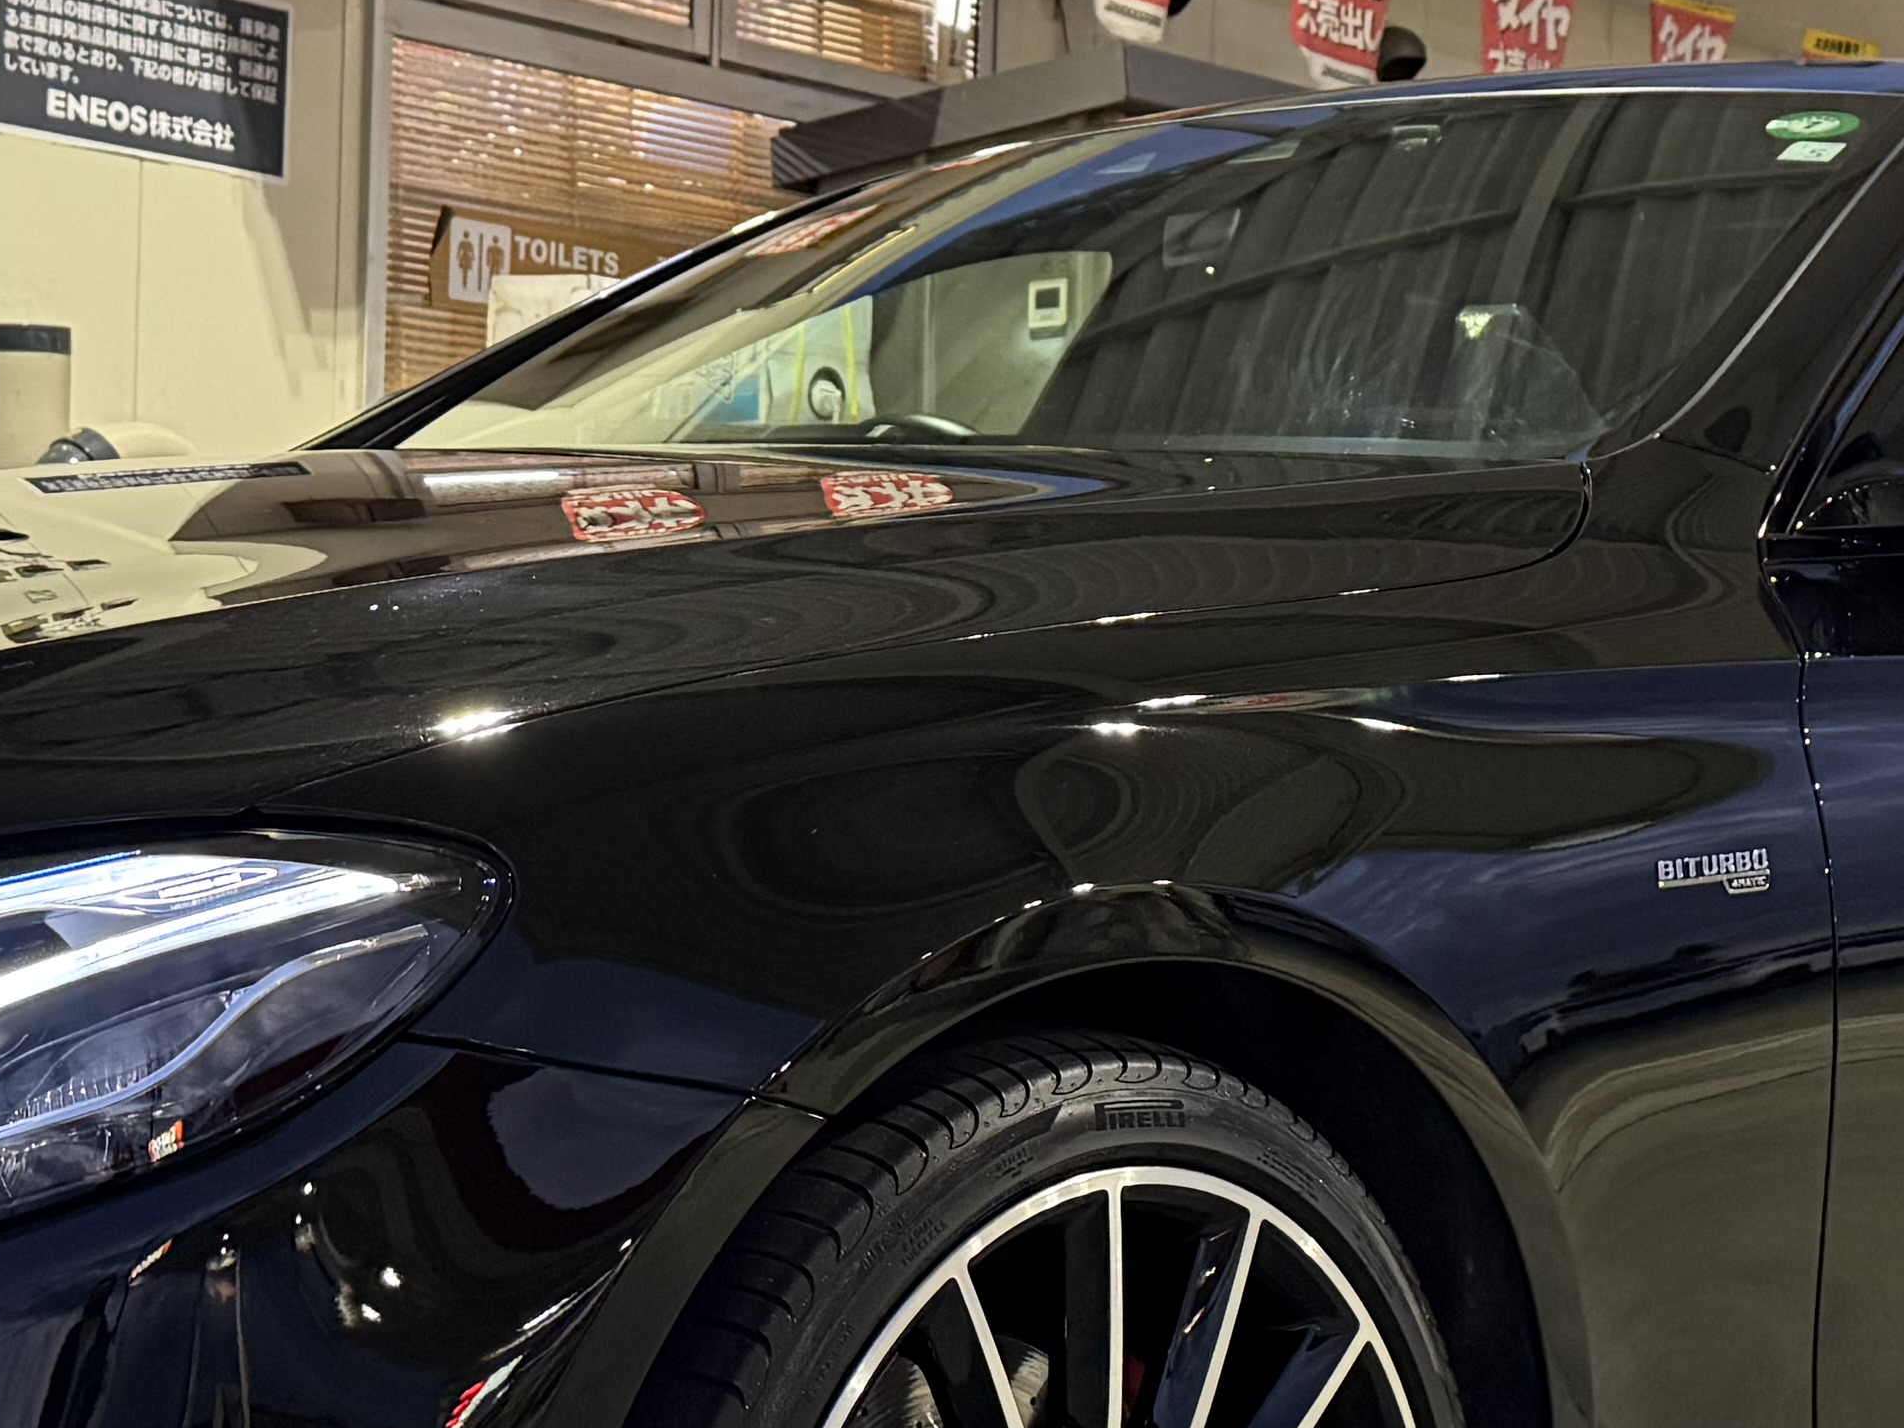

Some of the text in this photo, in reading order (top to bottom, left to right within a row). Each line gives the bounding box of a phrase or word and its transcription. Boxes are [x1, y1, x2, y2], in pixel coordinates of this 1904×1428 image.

[46, 87, 234, 151] ENEOS株式会社
[513, 233, 620, 276] TOILETS
[1657, 848, 1769, 880] BITURBO
[1094, 1099, 1186, 1131] PIRELLI
